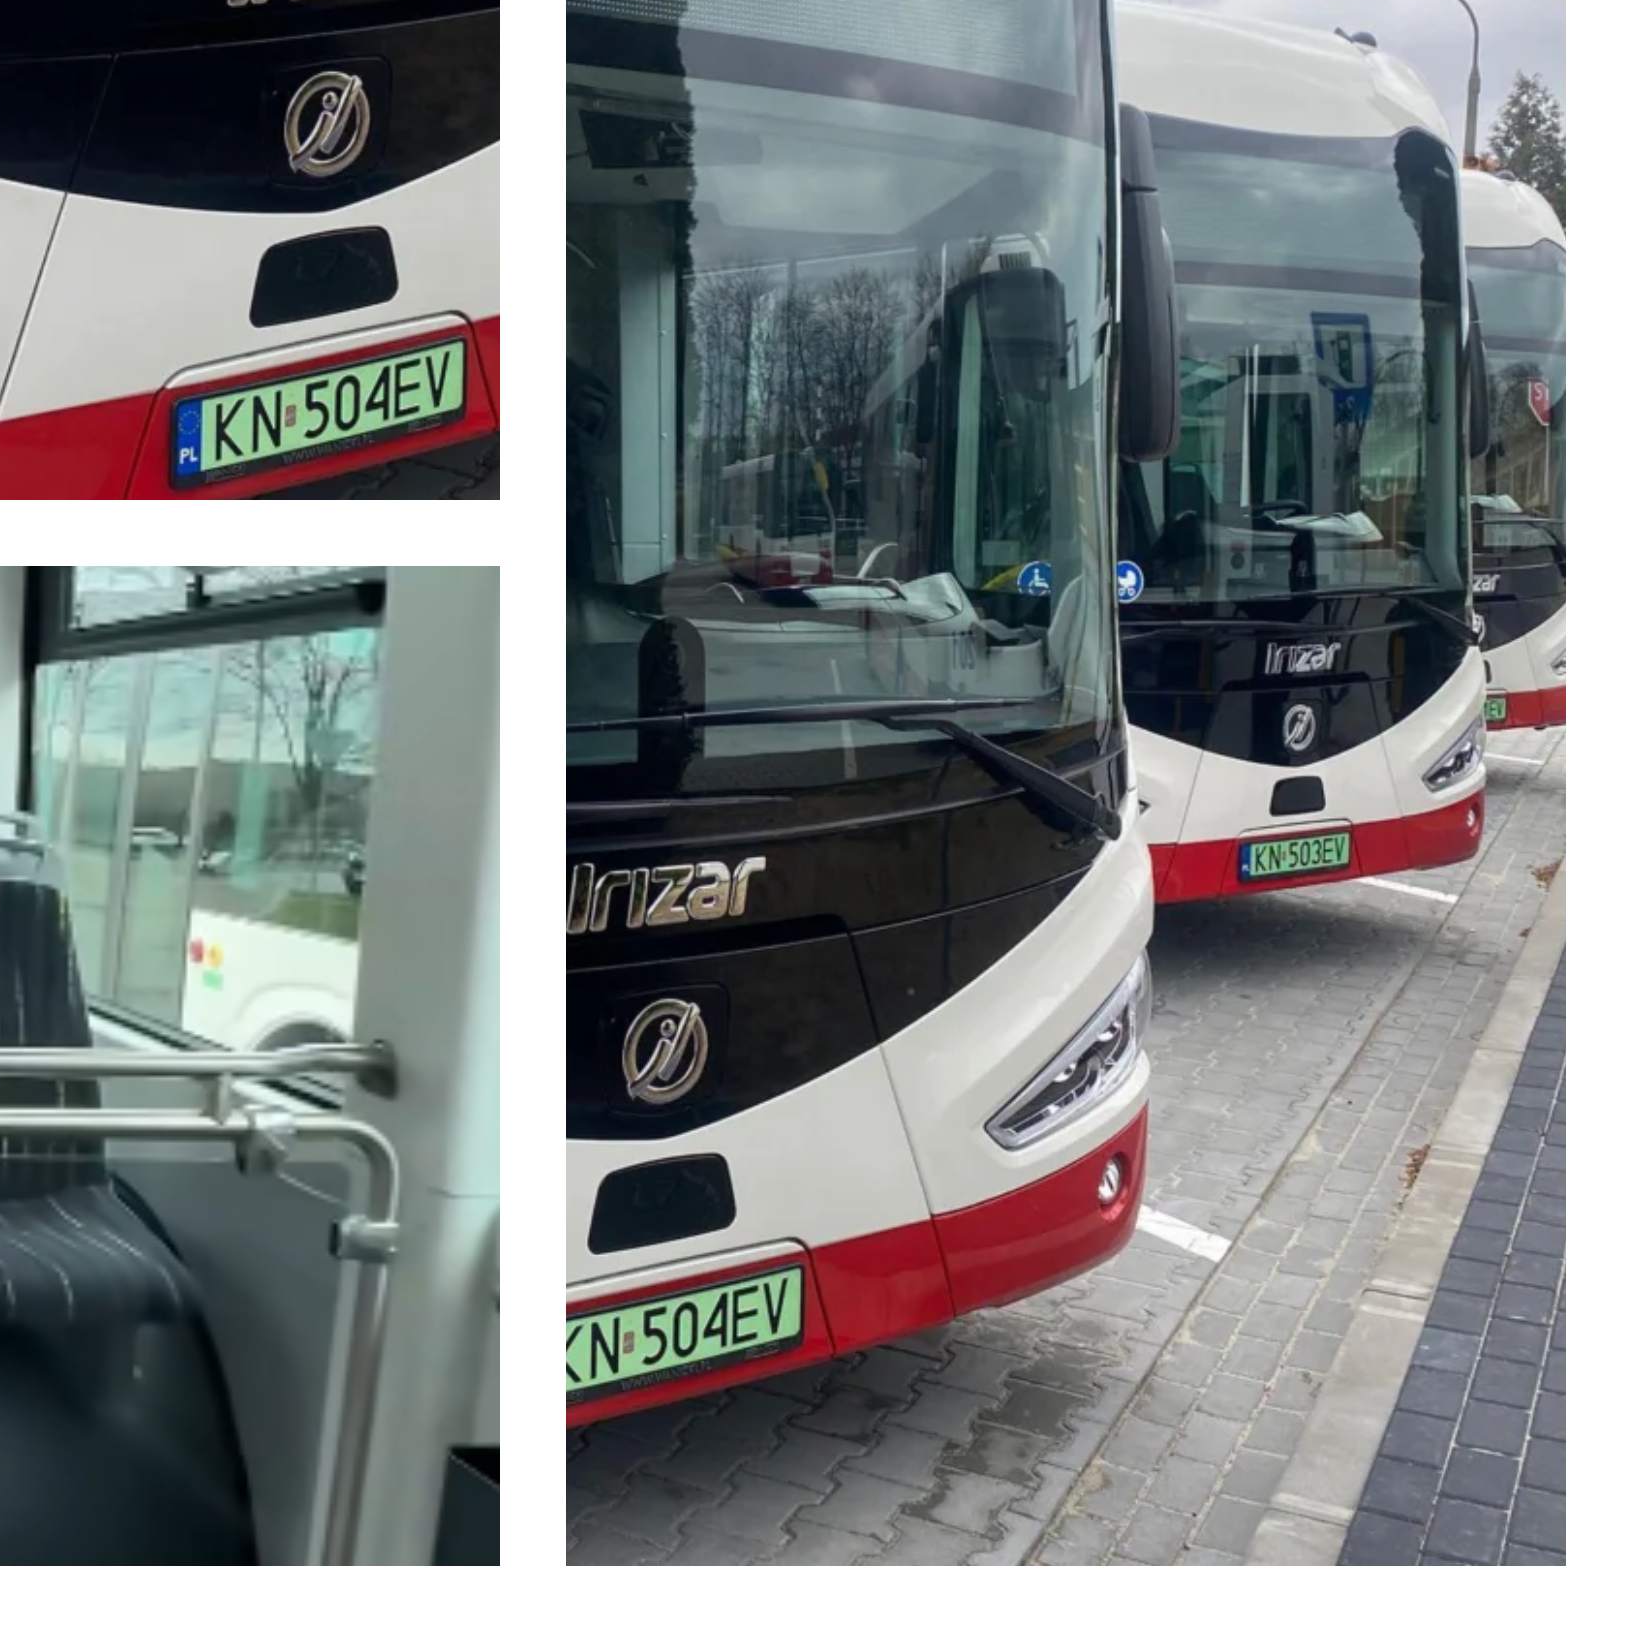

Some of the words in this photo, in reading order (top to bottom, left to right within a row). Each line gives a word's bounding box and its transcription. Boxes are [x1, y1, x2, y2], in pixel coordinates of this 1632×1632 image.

[215, 390, 282, 461] KN
[304, 350, 451, 439] 504EV
[179, 448, 198, 465] PL
[1473, 574, 1501, 592] zar
[1264, 641, 1342, 675] Irizar
[1288, 835, 1346, 868] 503EV
[566, 856, 767, 935] Irizar
[642, 1277, 789, 1365] 504EV
